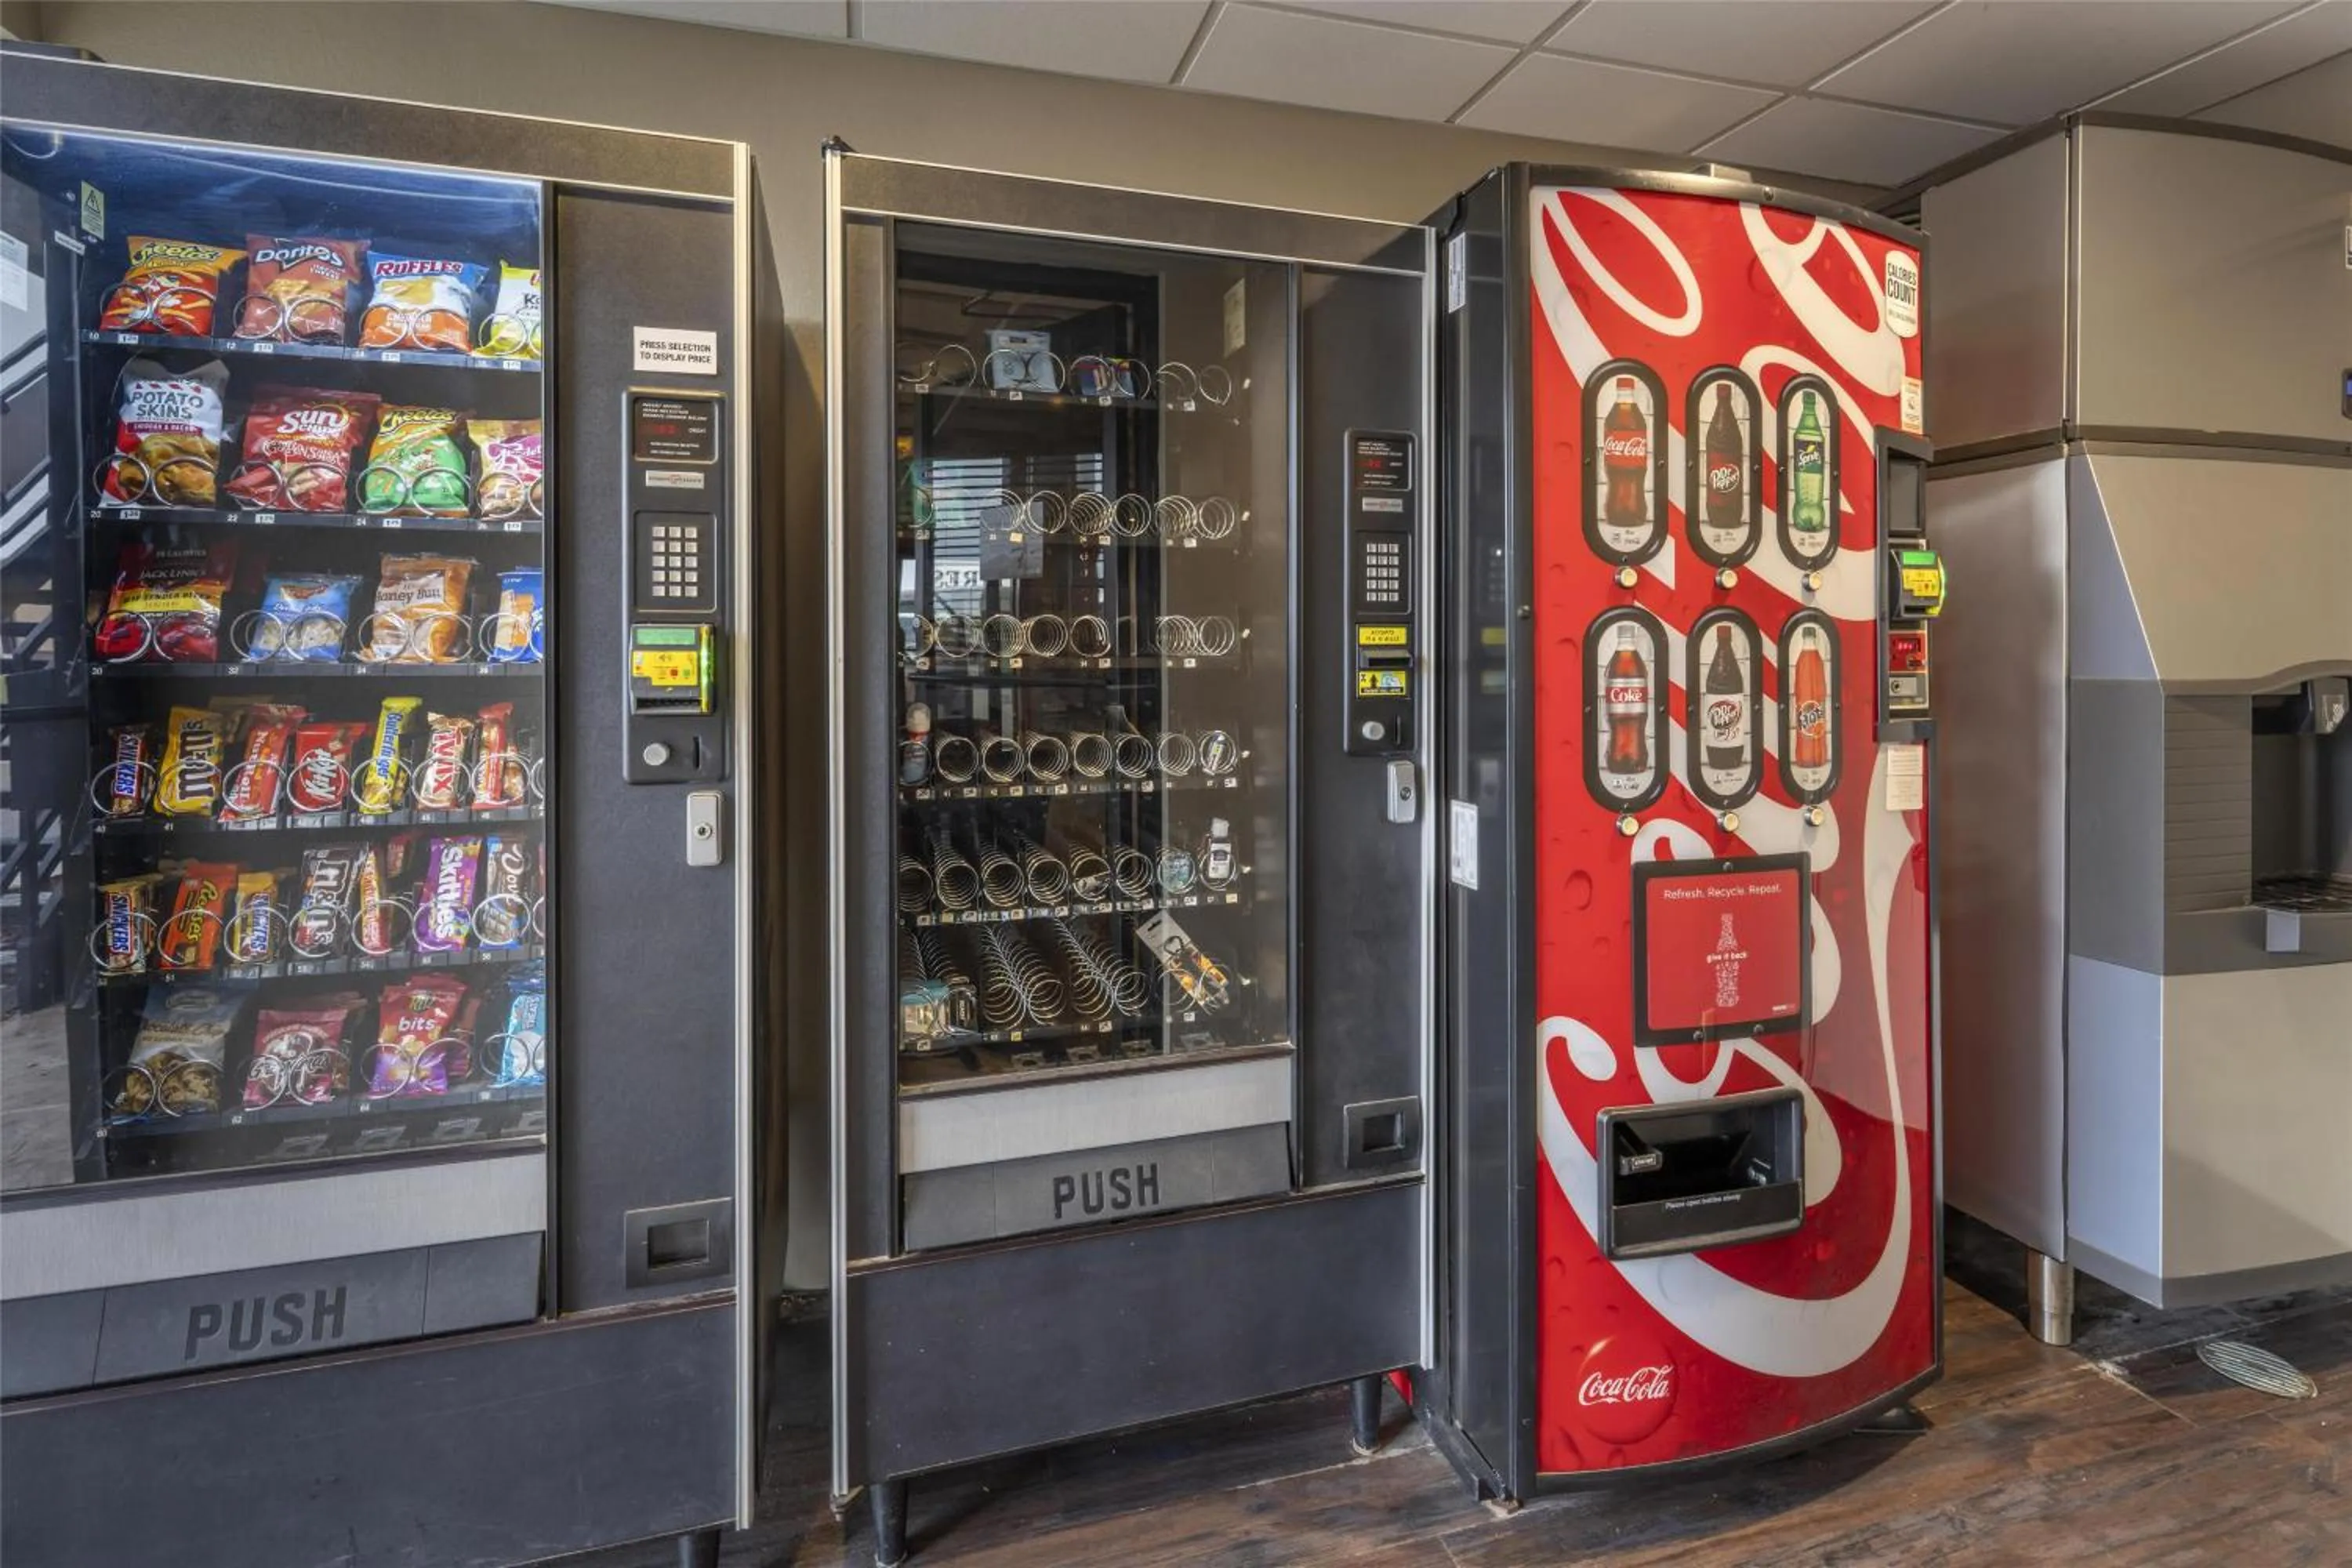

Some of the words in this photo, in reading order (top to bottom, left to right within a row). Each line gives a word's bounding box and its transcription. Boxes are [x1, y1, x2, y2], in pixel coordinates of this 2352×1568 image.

[256, 244, 343, 270] Doritos
[376, 260, 463, 276] RUFFLES
[1887, 263, 1916, 285] CALORIES
[1887, 278, 1916, 306] COUNT
[640, 339, 666, 350] PRESS
[668, 342, 711, 352] SELECTION
[640, 350, 652, 360] TO
[653, 352, 686, 362] DISPLAY
[688, 354, 712, 364] PRICE
[132, 391, 204, 408] POTATO
[136, 404, 194, 419] SKINS
[277, 409, 350, 434] Sun
[379, 409, 456, 436] Cheetos
[1605, 437, 1646, 456] Coca-Cola
[1610, 688, 1642, 703] Coke
[115, 733, 140, 797] SNICKERS
[435, 846, 463, 938] Skittles
[1664, 888, 1704, 899] Refresh.
[1749, 883, 1781, 895] Repeat.
[111, 895, 132, 953] SNICKERS
[251, 893, 270, 952] SNICKERS
[397, 1017, 436, 1032] bits
[1053, 1163, 1160, 1219] PUSH
[183, 1286, 348, 1361] PUSH
[1578, 1365, 1674, 1406] Coca-Cola
